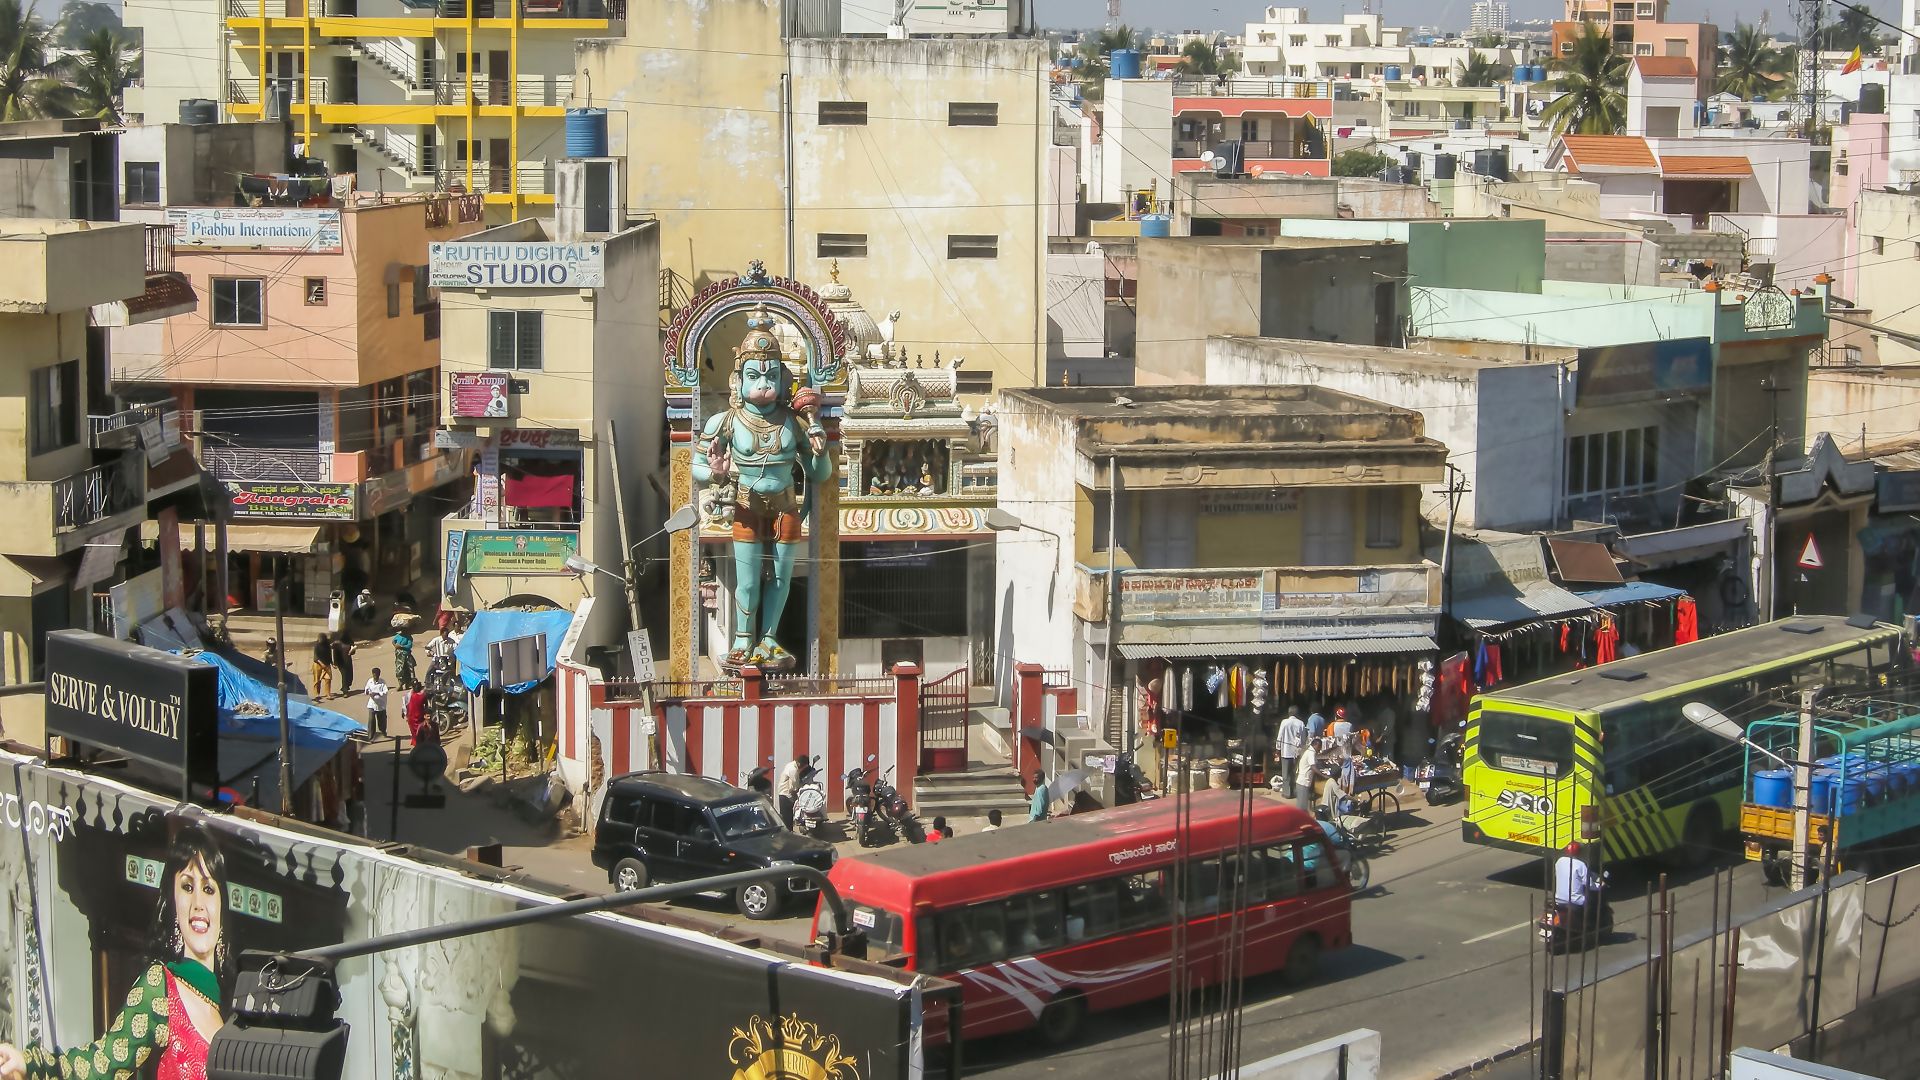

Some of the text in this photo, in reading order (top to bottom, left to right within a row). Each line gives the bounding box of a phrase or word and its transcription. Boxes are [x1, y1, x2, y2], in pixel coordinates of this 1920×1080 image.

[191, 222, 235, 236] Prabhu
[445, 246, 590, 261] RUTHU DIGITAL
[467, 263, 568, 285] STUDIO
[232, 491, 353, 507] Anugraha
[51, 671, 98, 716] SERVE
[101, 684, 118, 722] &
[118, 690, 181, 740] VOLLEY
